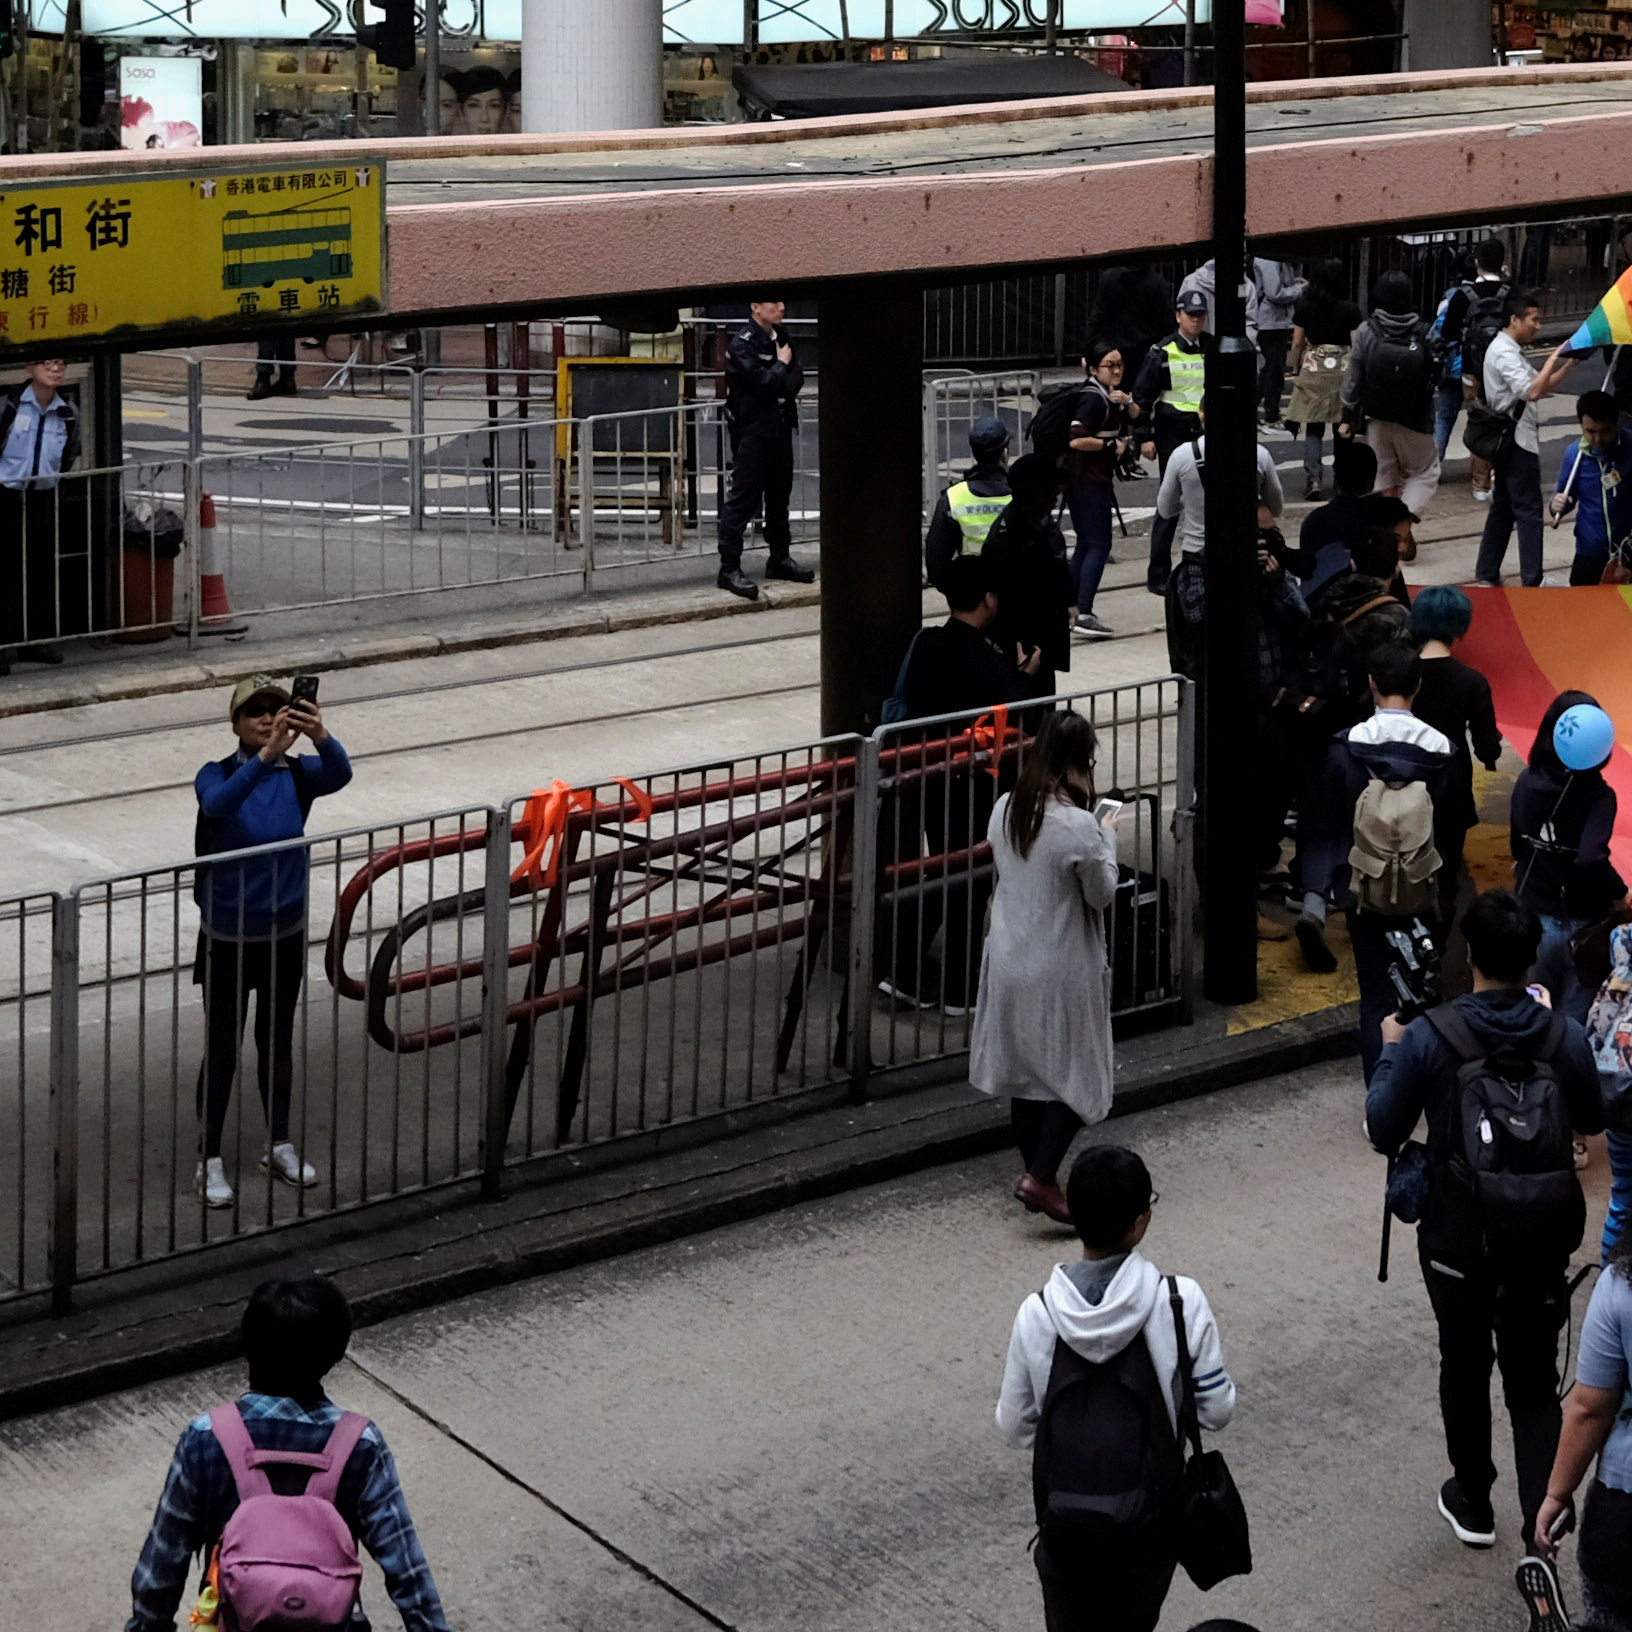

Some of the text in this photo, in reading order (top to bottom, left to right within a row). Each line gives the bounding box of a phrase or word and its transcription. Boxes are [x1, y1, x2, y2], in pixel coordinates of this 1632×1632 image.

[225, 170, 348, 196] 香港電車有限公司
[0, 264, 76, 300] 糖街
[236, 284, 341, 318] 電車站
